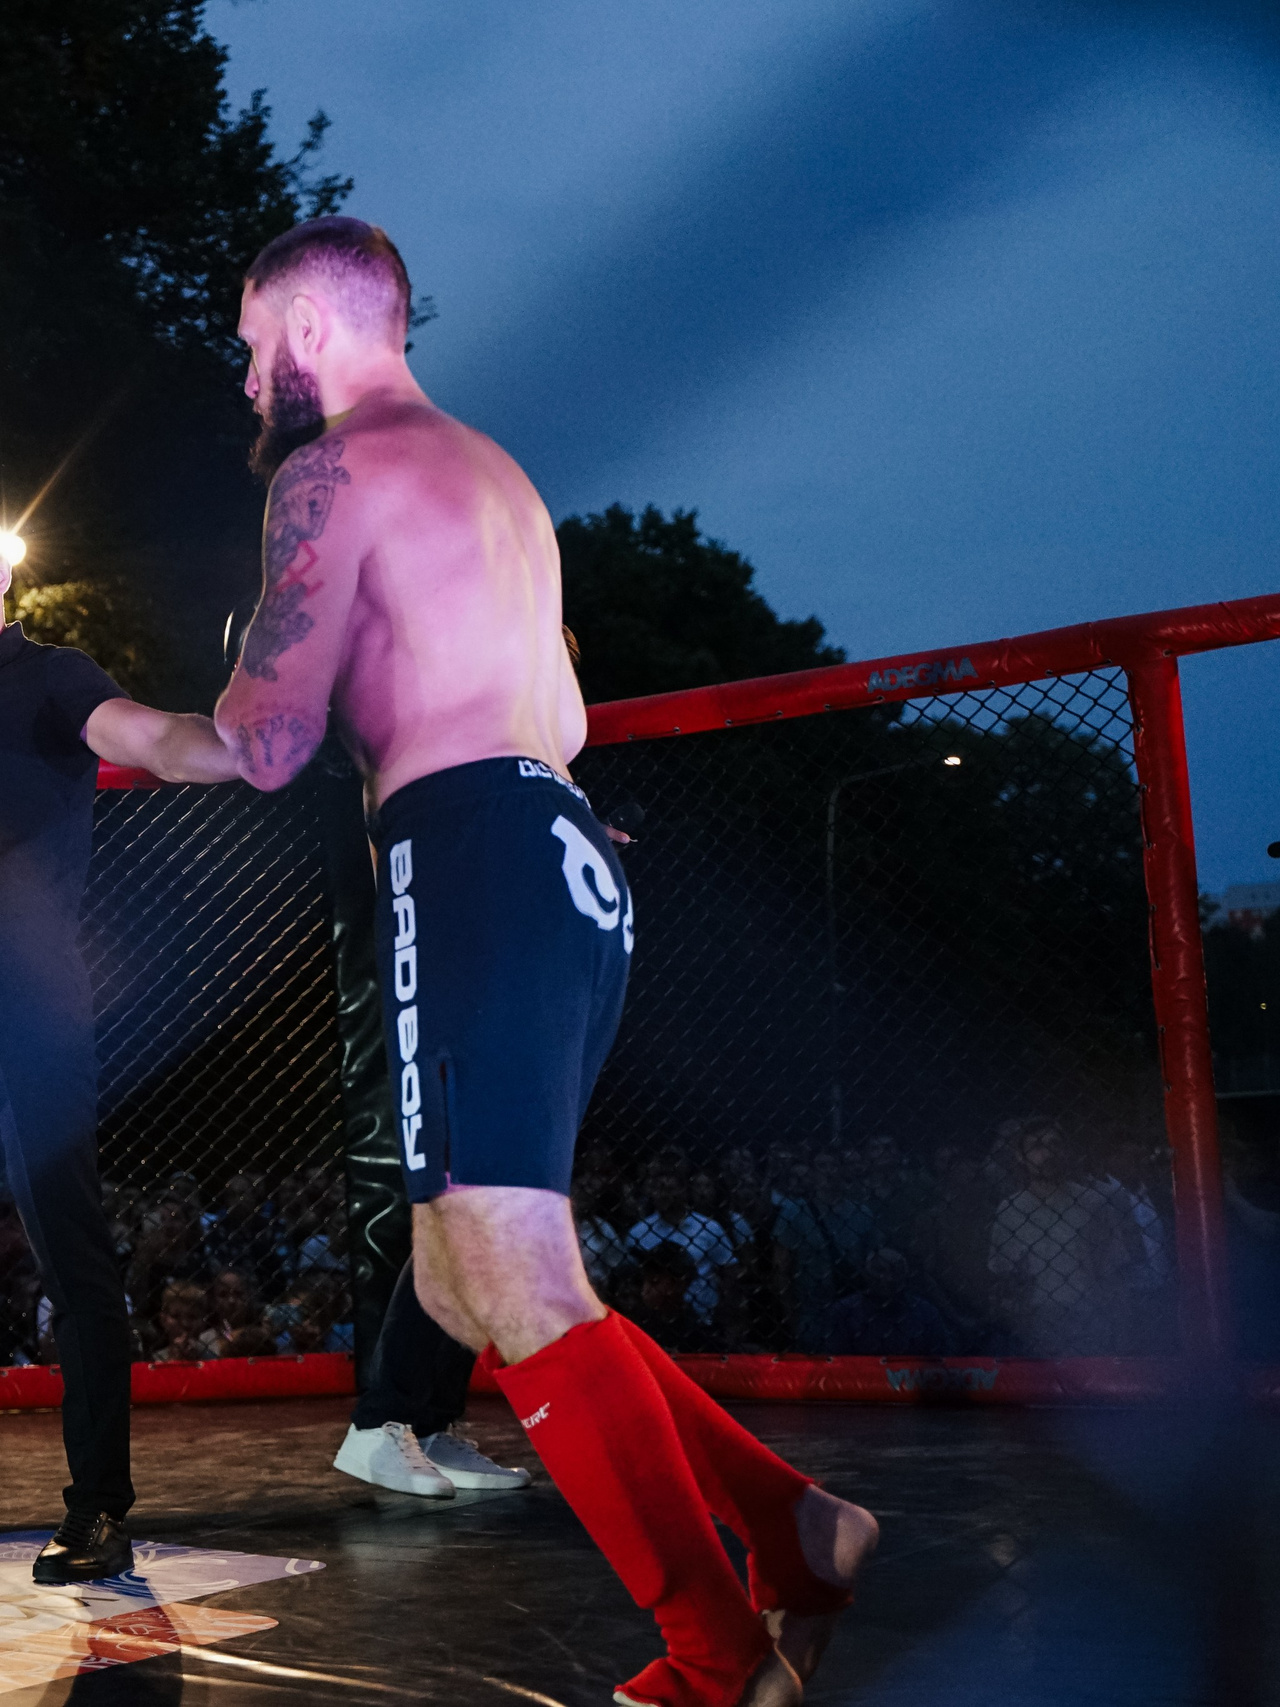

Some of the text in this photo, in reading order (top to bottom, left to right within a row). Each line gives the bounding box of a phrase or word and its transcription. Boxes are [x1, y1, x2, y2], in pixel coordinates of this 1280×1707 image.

[867, 657, 979, 693] ADEGMA
[390, 838, 426, 1171] BAD BOY
